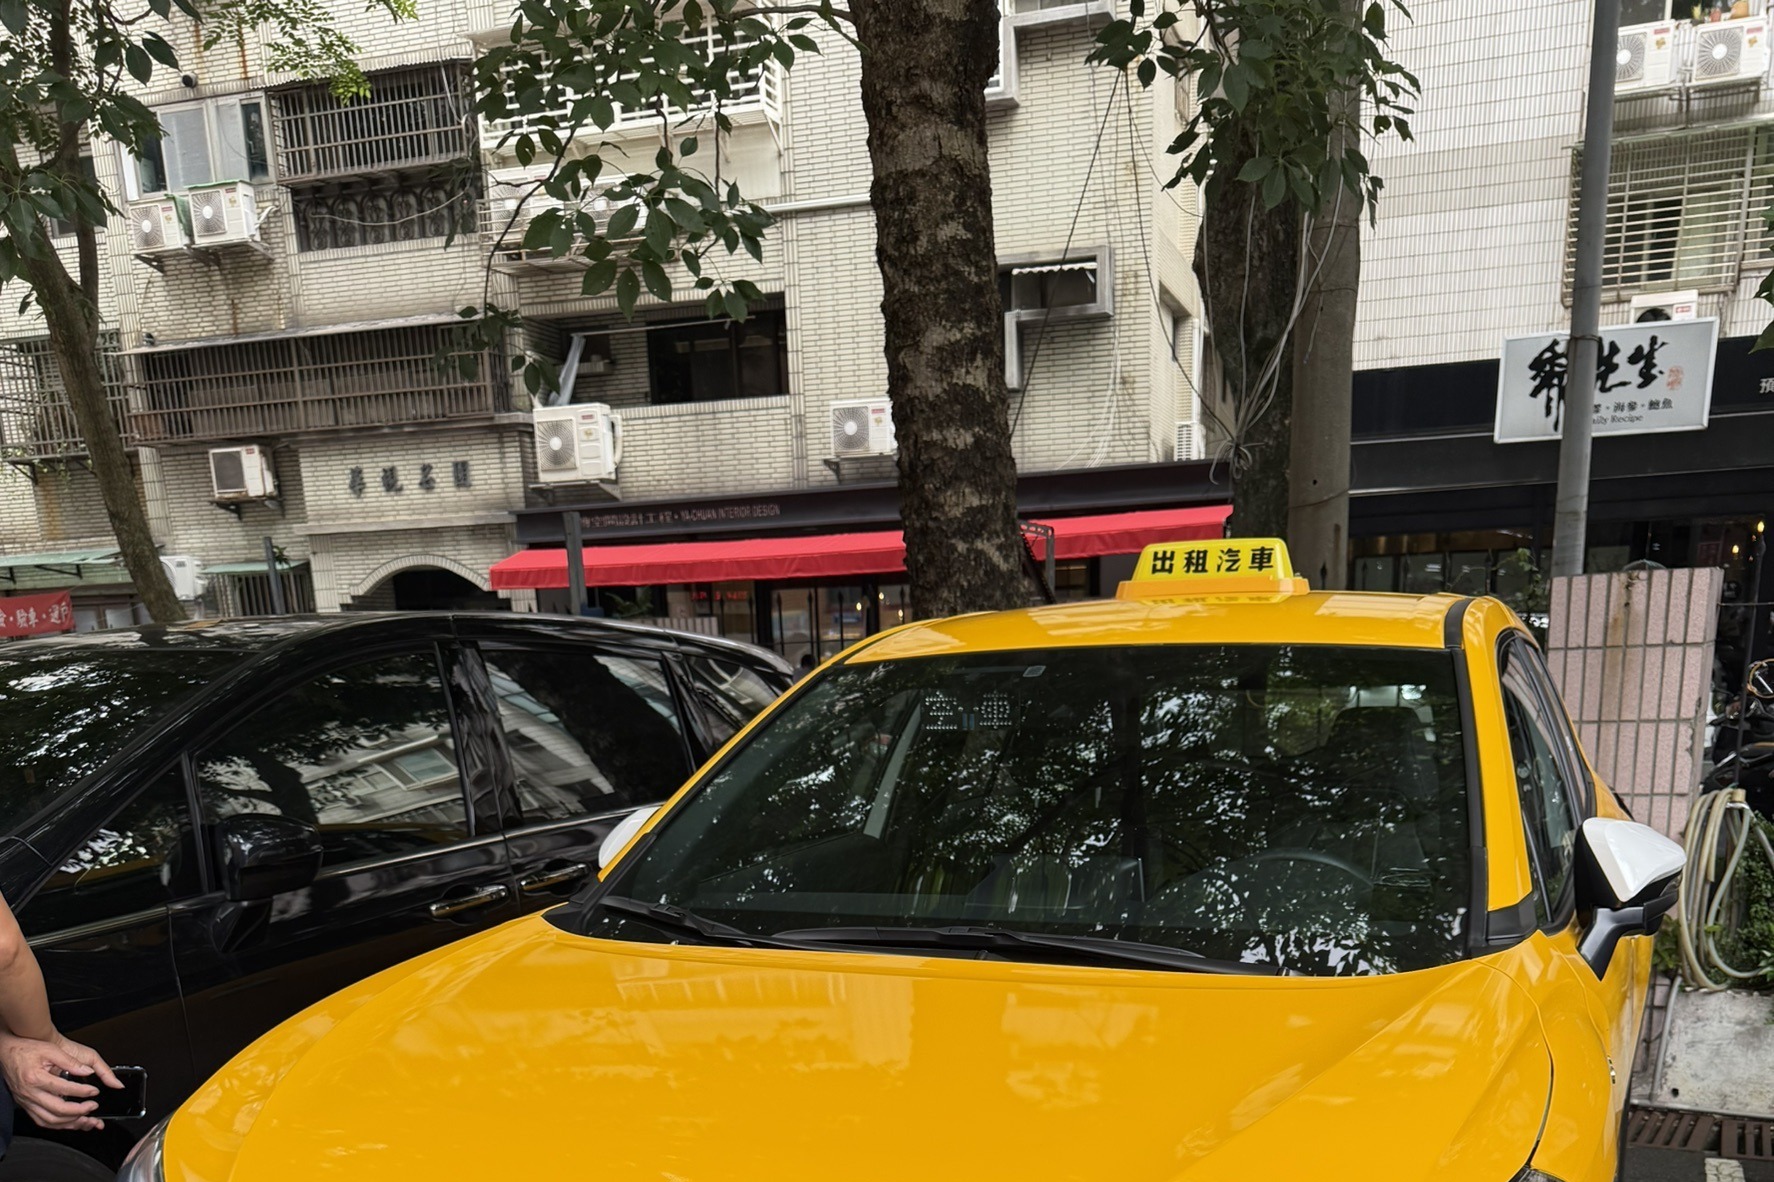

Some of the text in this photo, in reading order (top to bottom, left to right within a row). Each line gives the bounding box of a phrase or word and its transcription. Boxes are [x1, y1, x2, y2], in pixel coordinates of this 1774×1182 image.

[1611, 414, 1643, 424] Recipe
[718, 506, 751, 519] INTERIOR
[753, 504, 780, 517] DESIGN
[1151, 546, 1275, 575] 出租汽車
